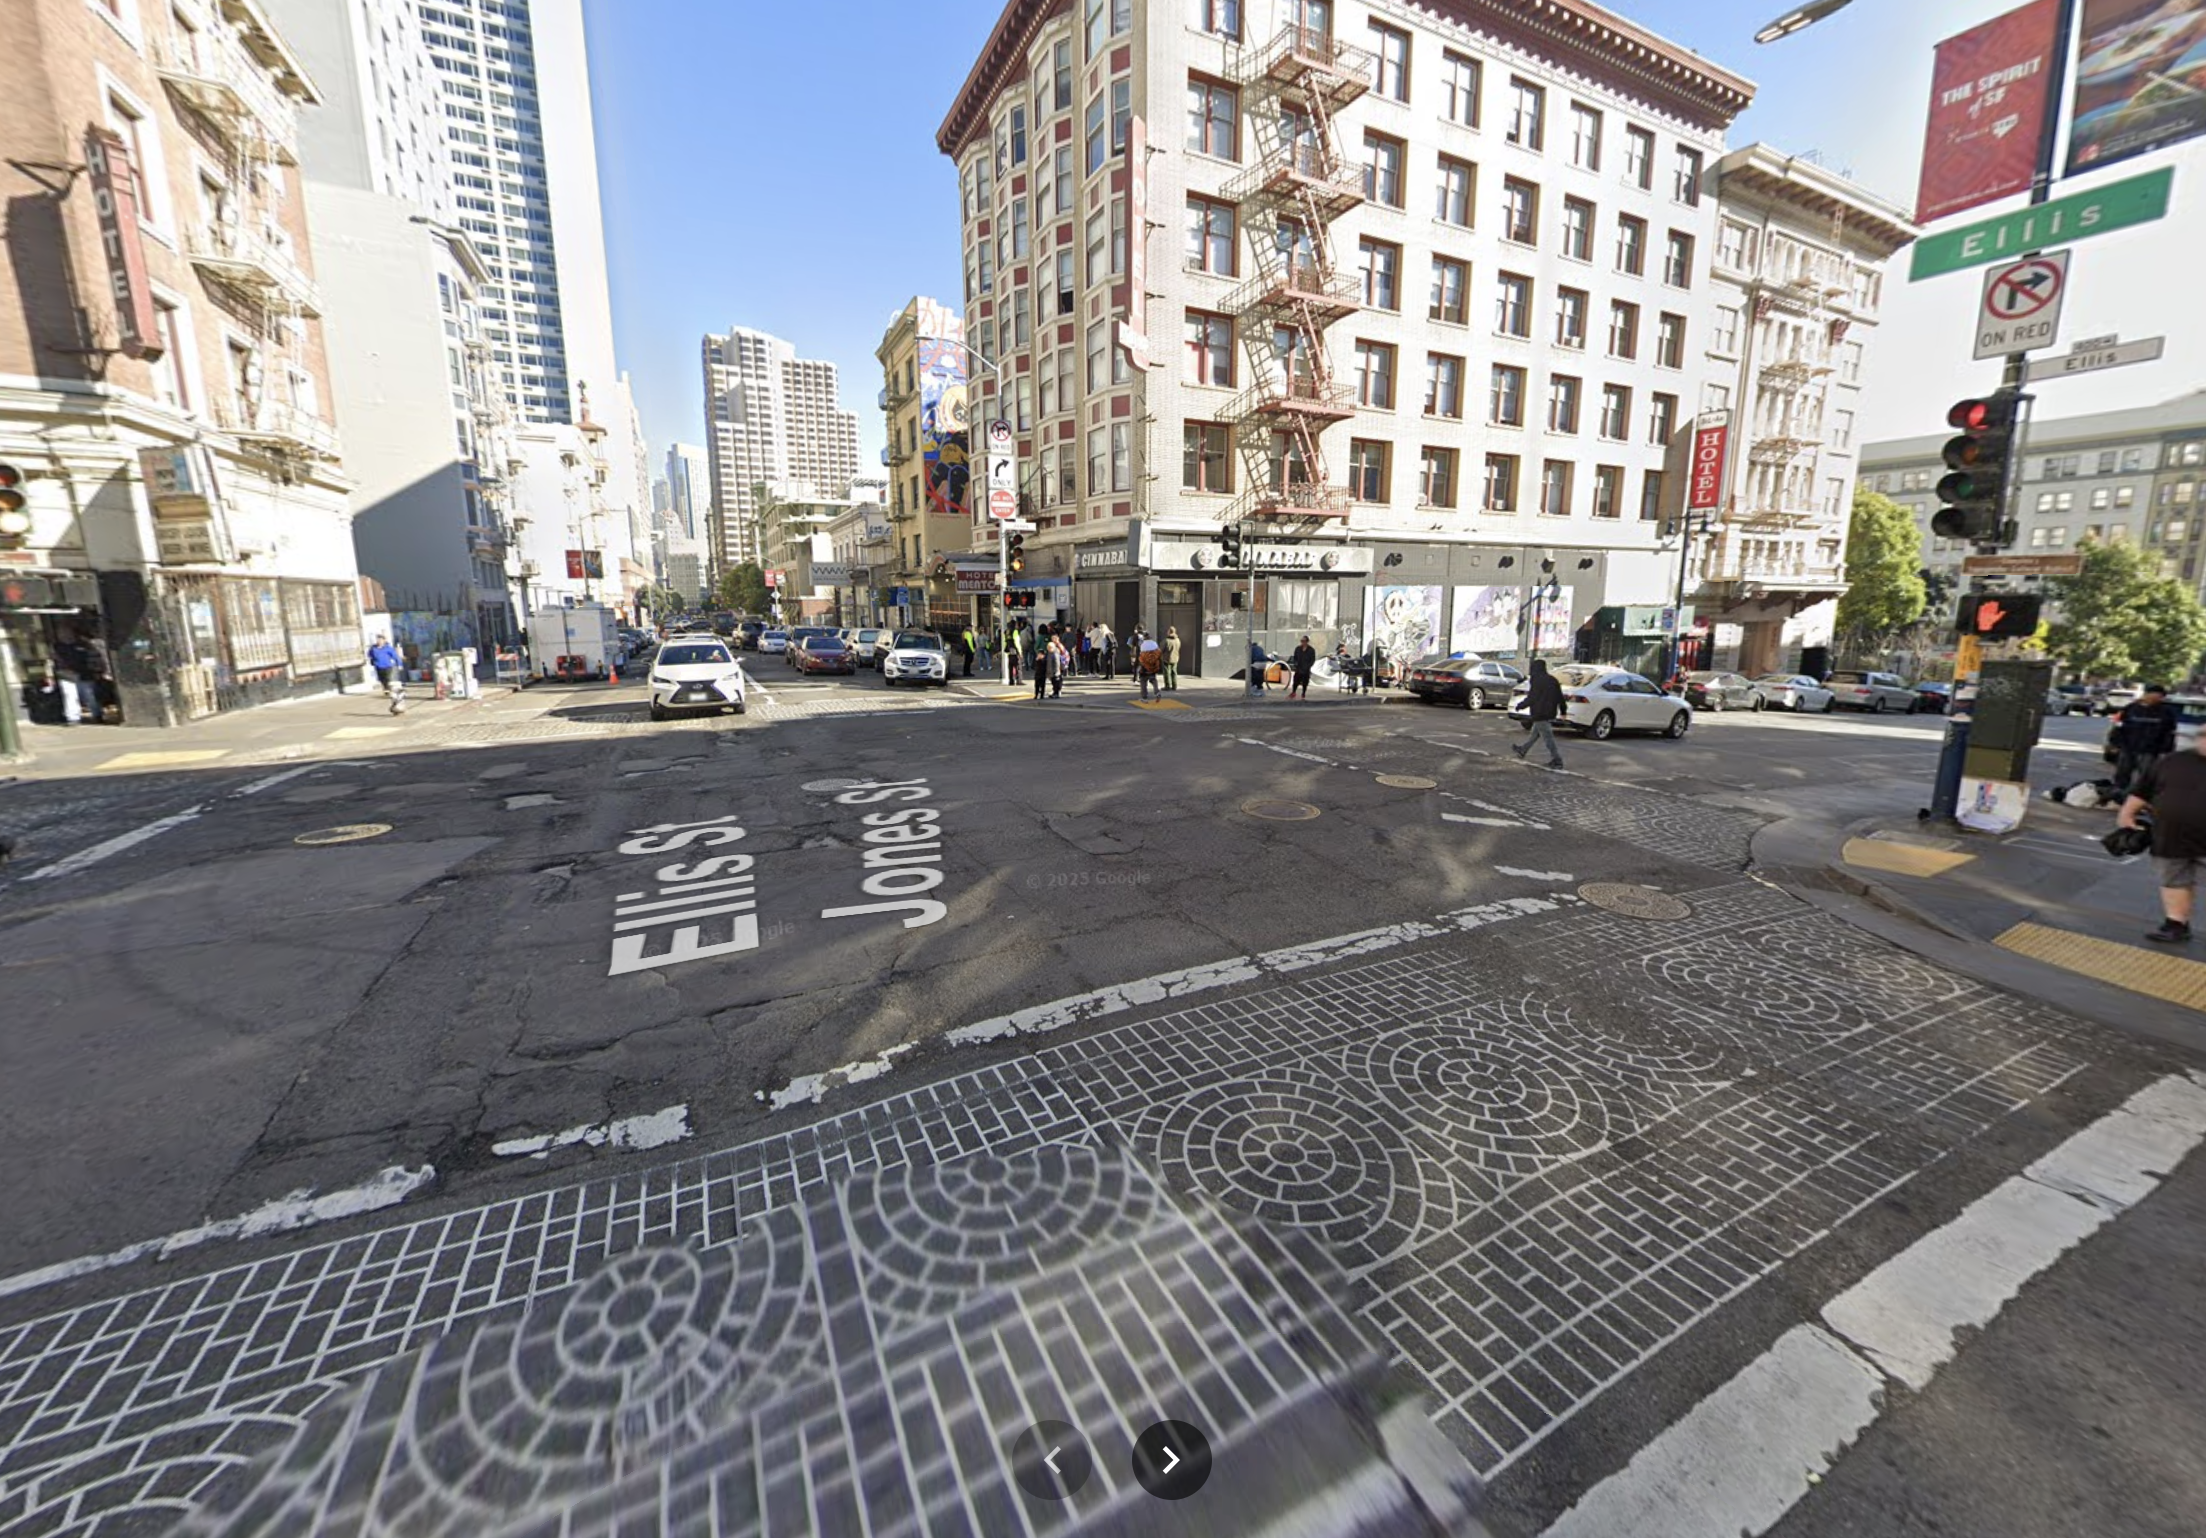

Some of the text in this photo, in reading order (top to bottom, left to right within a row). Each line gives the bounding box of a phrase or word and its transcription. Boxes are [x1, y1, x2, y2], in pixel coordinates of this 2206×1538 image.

[1941, 55, 2042, 107] THE SPIRIT
[1983, 86, 2007, 107] SF
[88, 143, 134, 339] HOTEL
[1960, 204, 2102, 259] Ellis
[1982, 321, 2051, 348] ON RED
[2065, 352, 2117, 371] Ellis
[1695, 432, 1721, 504] HOTEL
[992, 479, 1011, 487] ONLY
[1238, 550, 1317, 568] INNABAR
[958, 580, 1000, 589] MENTO
